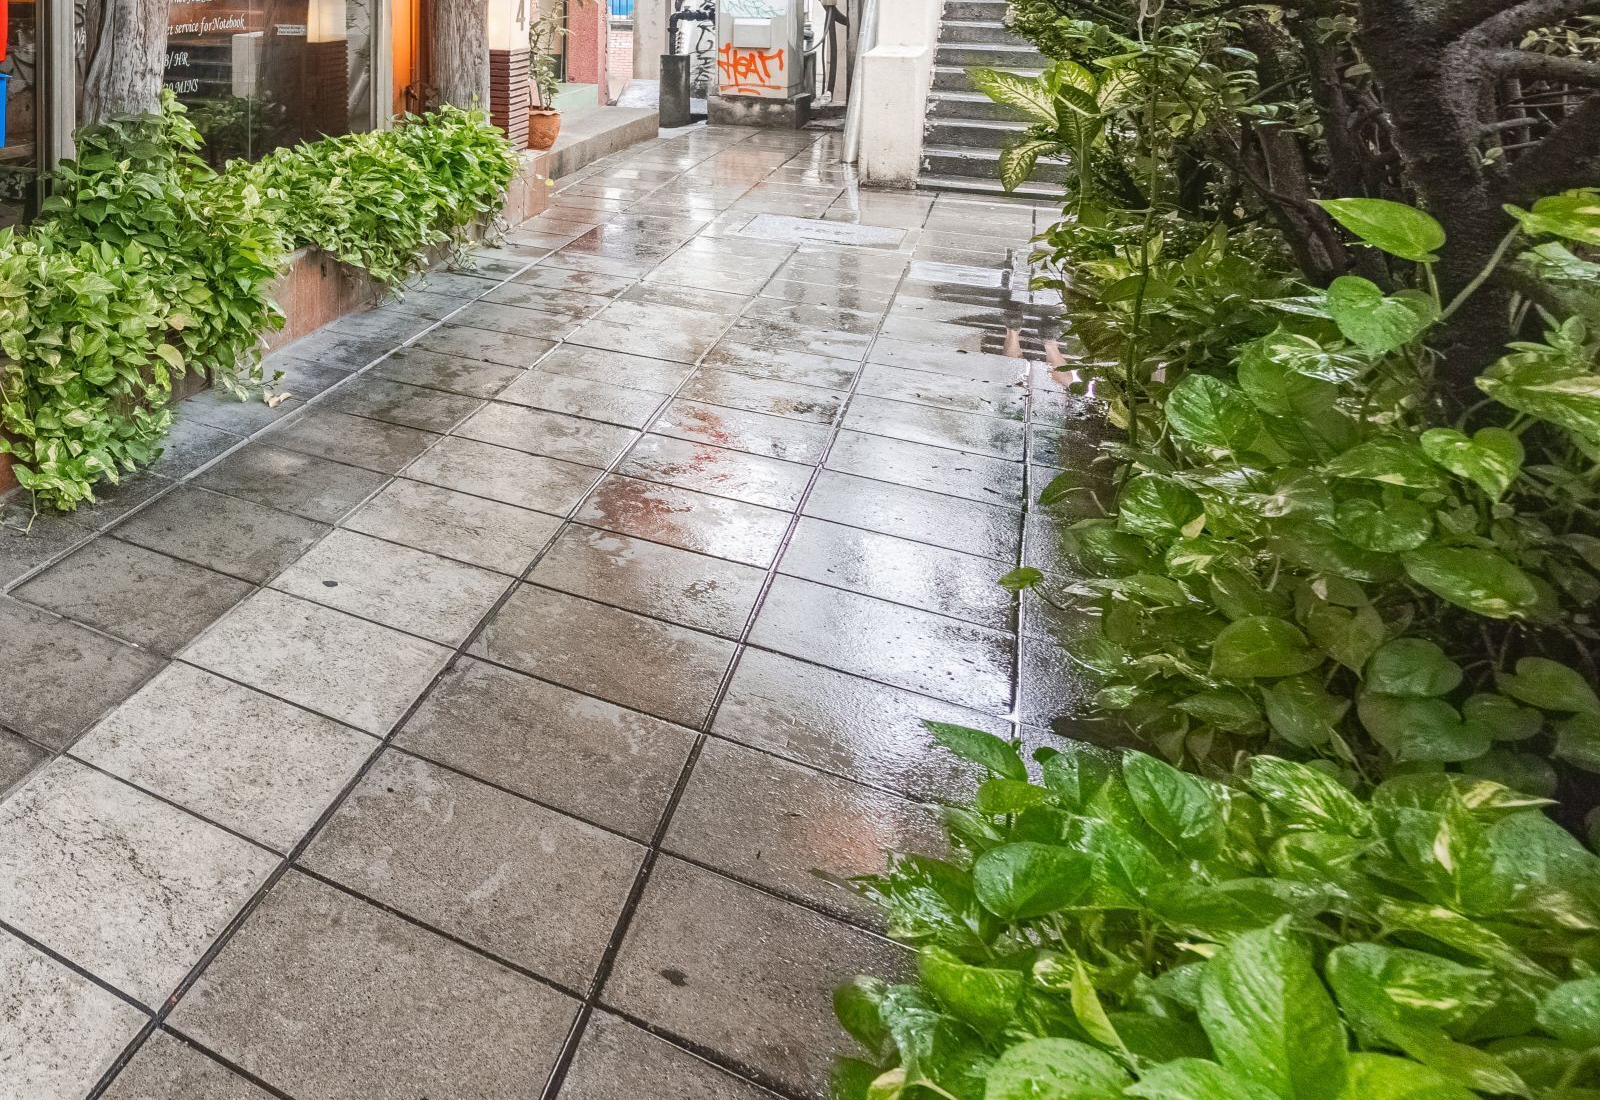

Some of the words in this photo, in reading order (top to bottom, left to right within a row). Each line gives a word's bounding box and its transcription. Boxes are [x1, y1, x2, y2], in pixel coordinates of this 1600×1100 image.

[175, 19, 199, 35] service
[174, 51, 190, 67] HR
[175, 78, 199, 94] MINS
